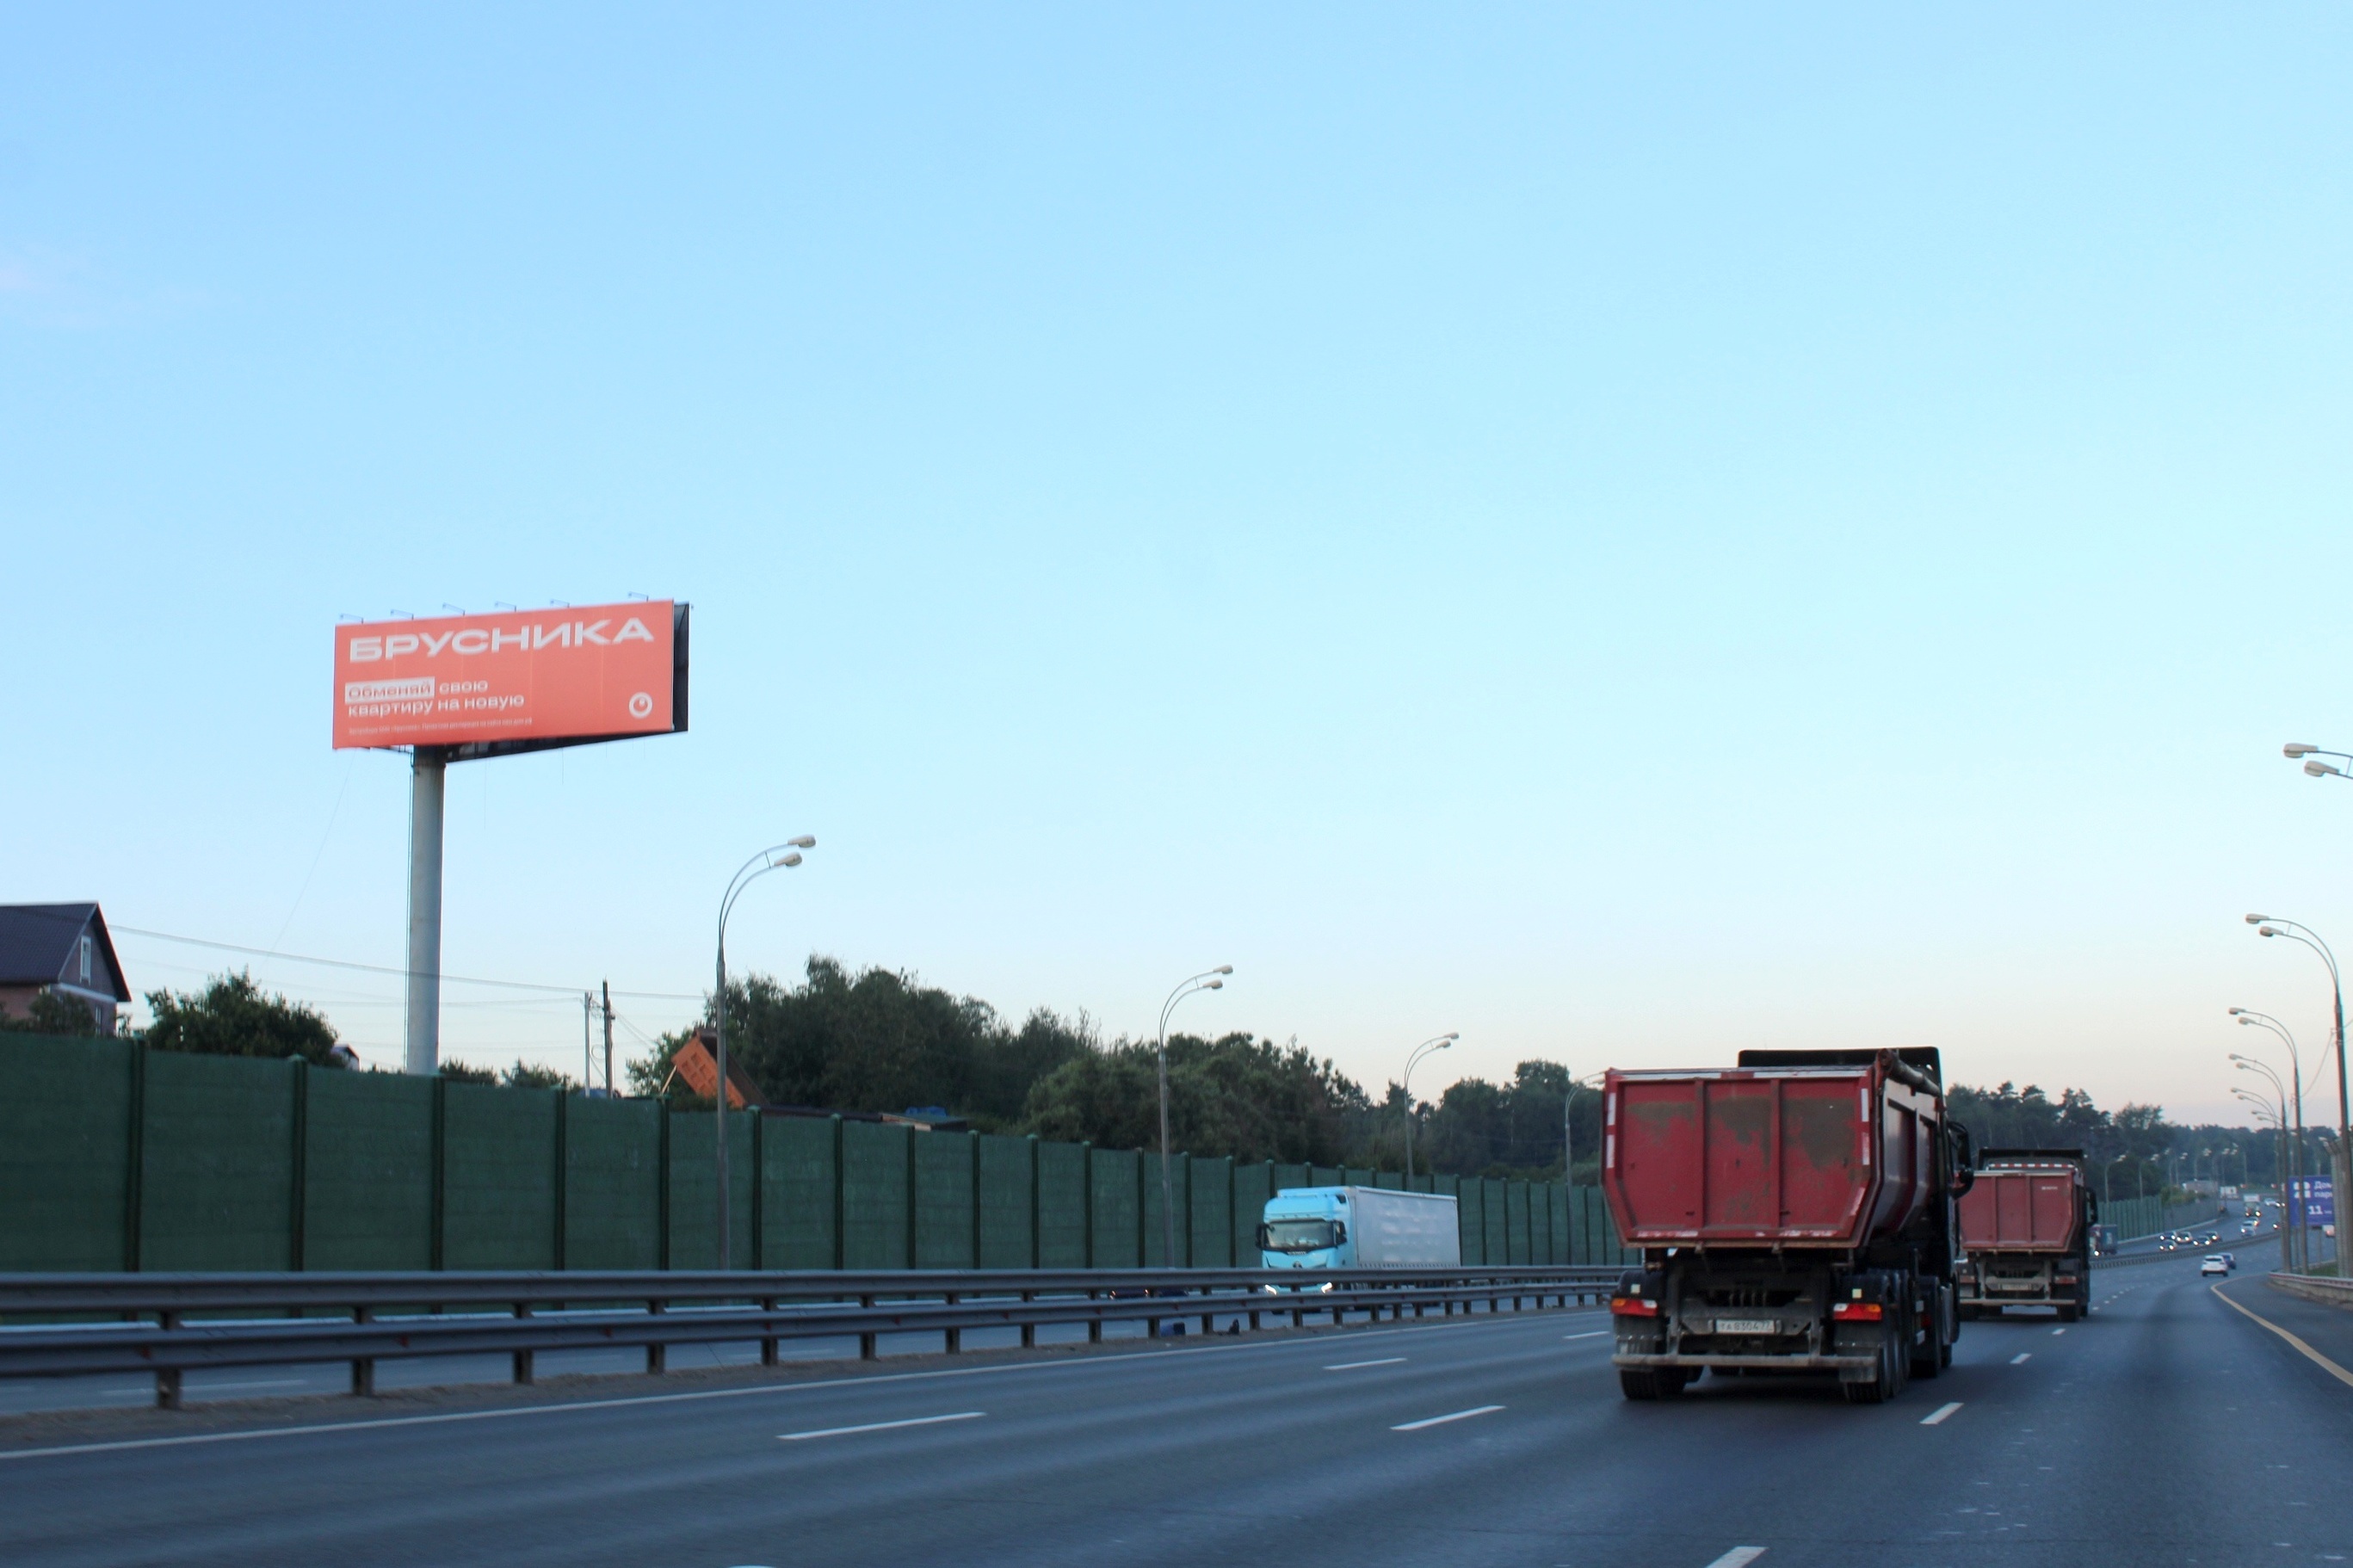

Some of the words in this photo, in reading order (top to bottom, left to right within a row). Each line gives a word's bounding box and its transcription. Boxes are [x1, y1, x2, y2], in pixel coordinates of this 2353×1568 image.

[349, 617, 655, 664] БРУСНИКА
[349, 682, 431, 700] Обменяй
[439, 679, 489, 695] свою
[349, 699, 434, 719] квартиру
[438, 697, 460, 712] на
[464, 694, 525, 712] новую
